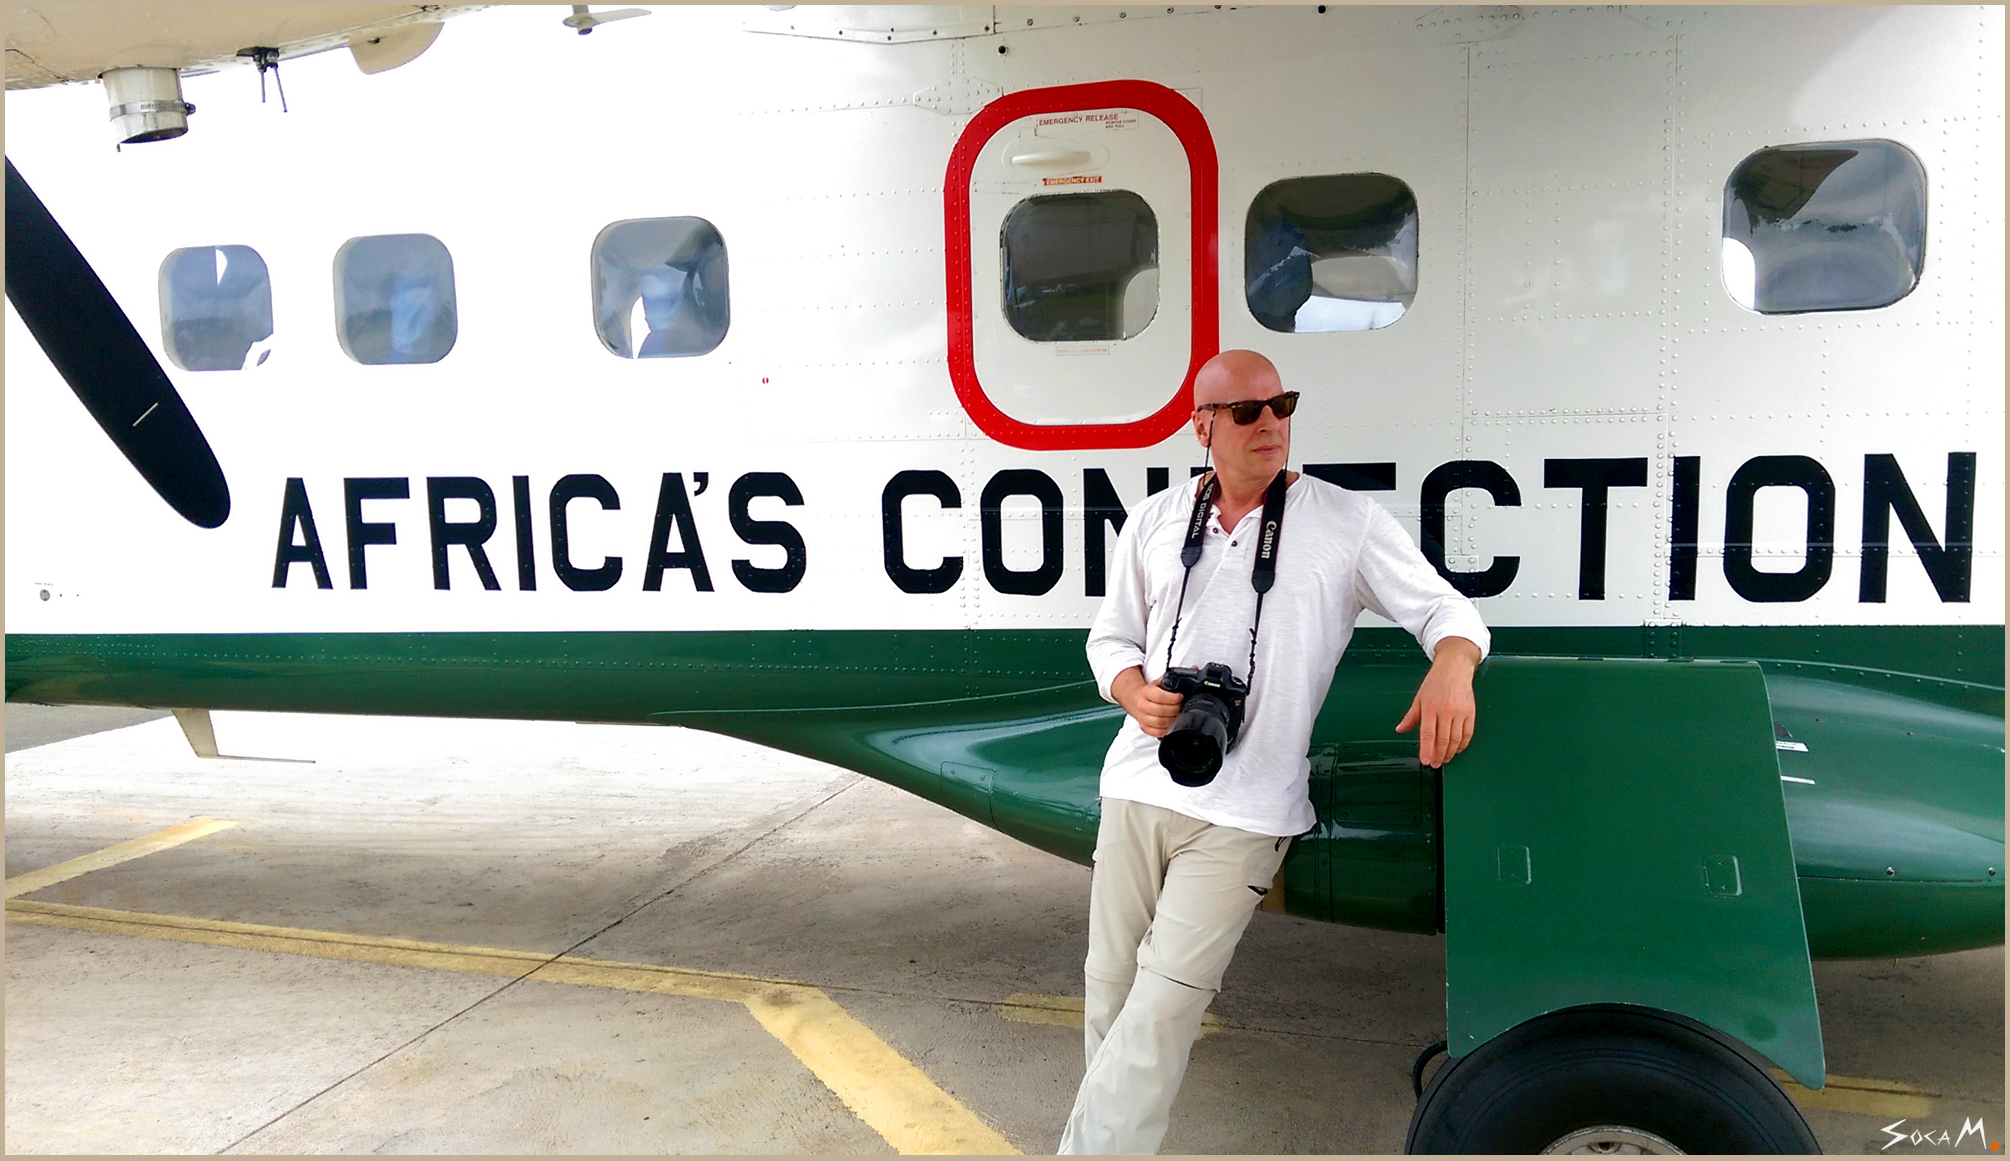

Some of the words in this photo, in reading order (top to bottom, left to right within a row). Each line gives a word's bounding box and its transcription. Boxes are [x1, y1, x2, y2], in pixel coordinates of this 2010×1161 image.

[1039, 116, 1083, 126] EMERGENCY
[1085, 113, 1119, 122] RELEASE
[1046, 177, 1084, 185] EMERGENCY
[272, 472, 807, 593] AFRICA'S
[882, 452, 1977, 604] CONCTION
[1191, 502, 1207, 539] DIGITAL
[1261, 520, 1277, 559] Canon
